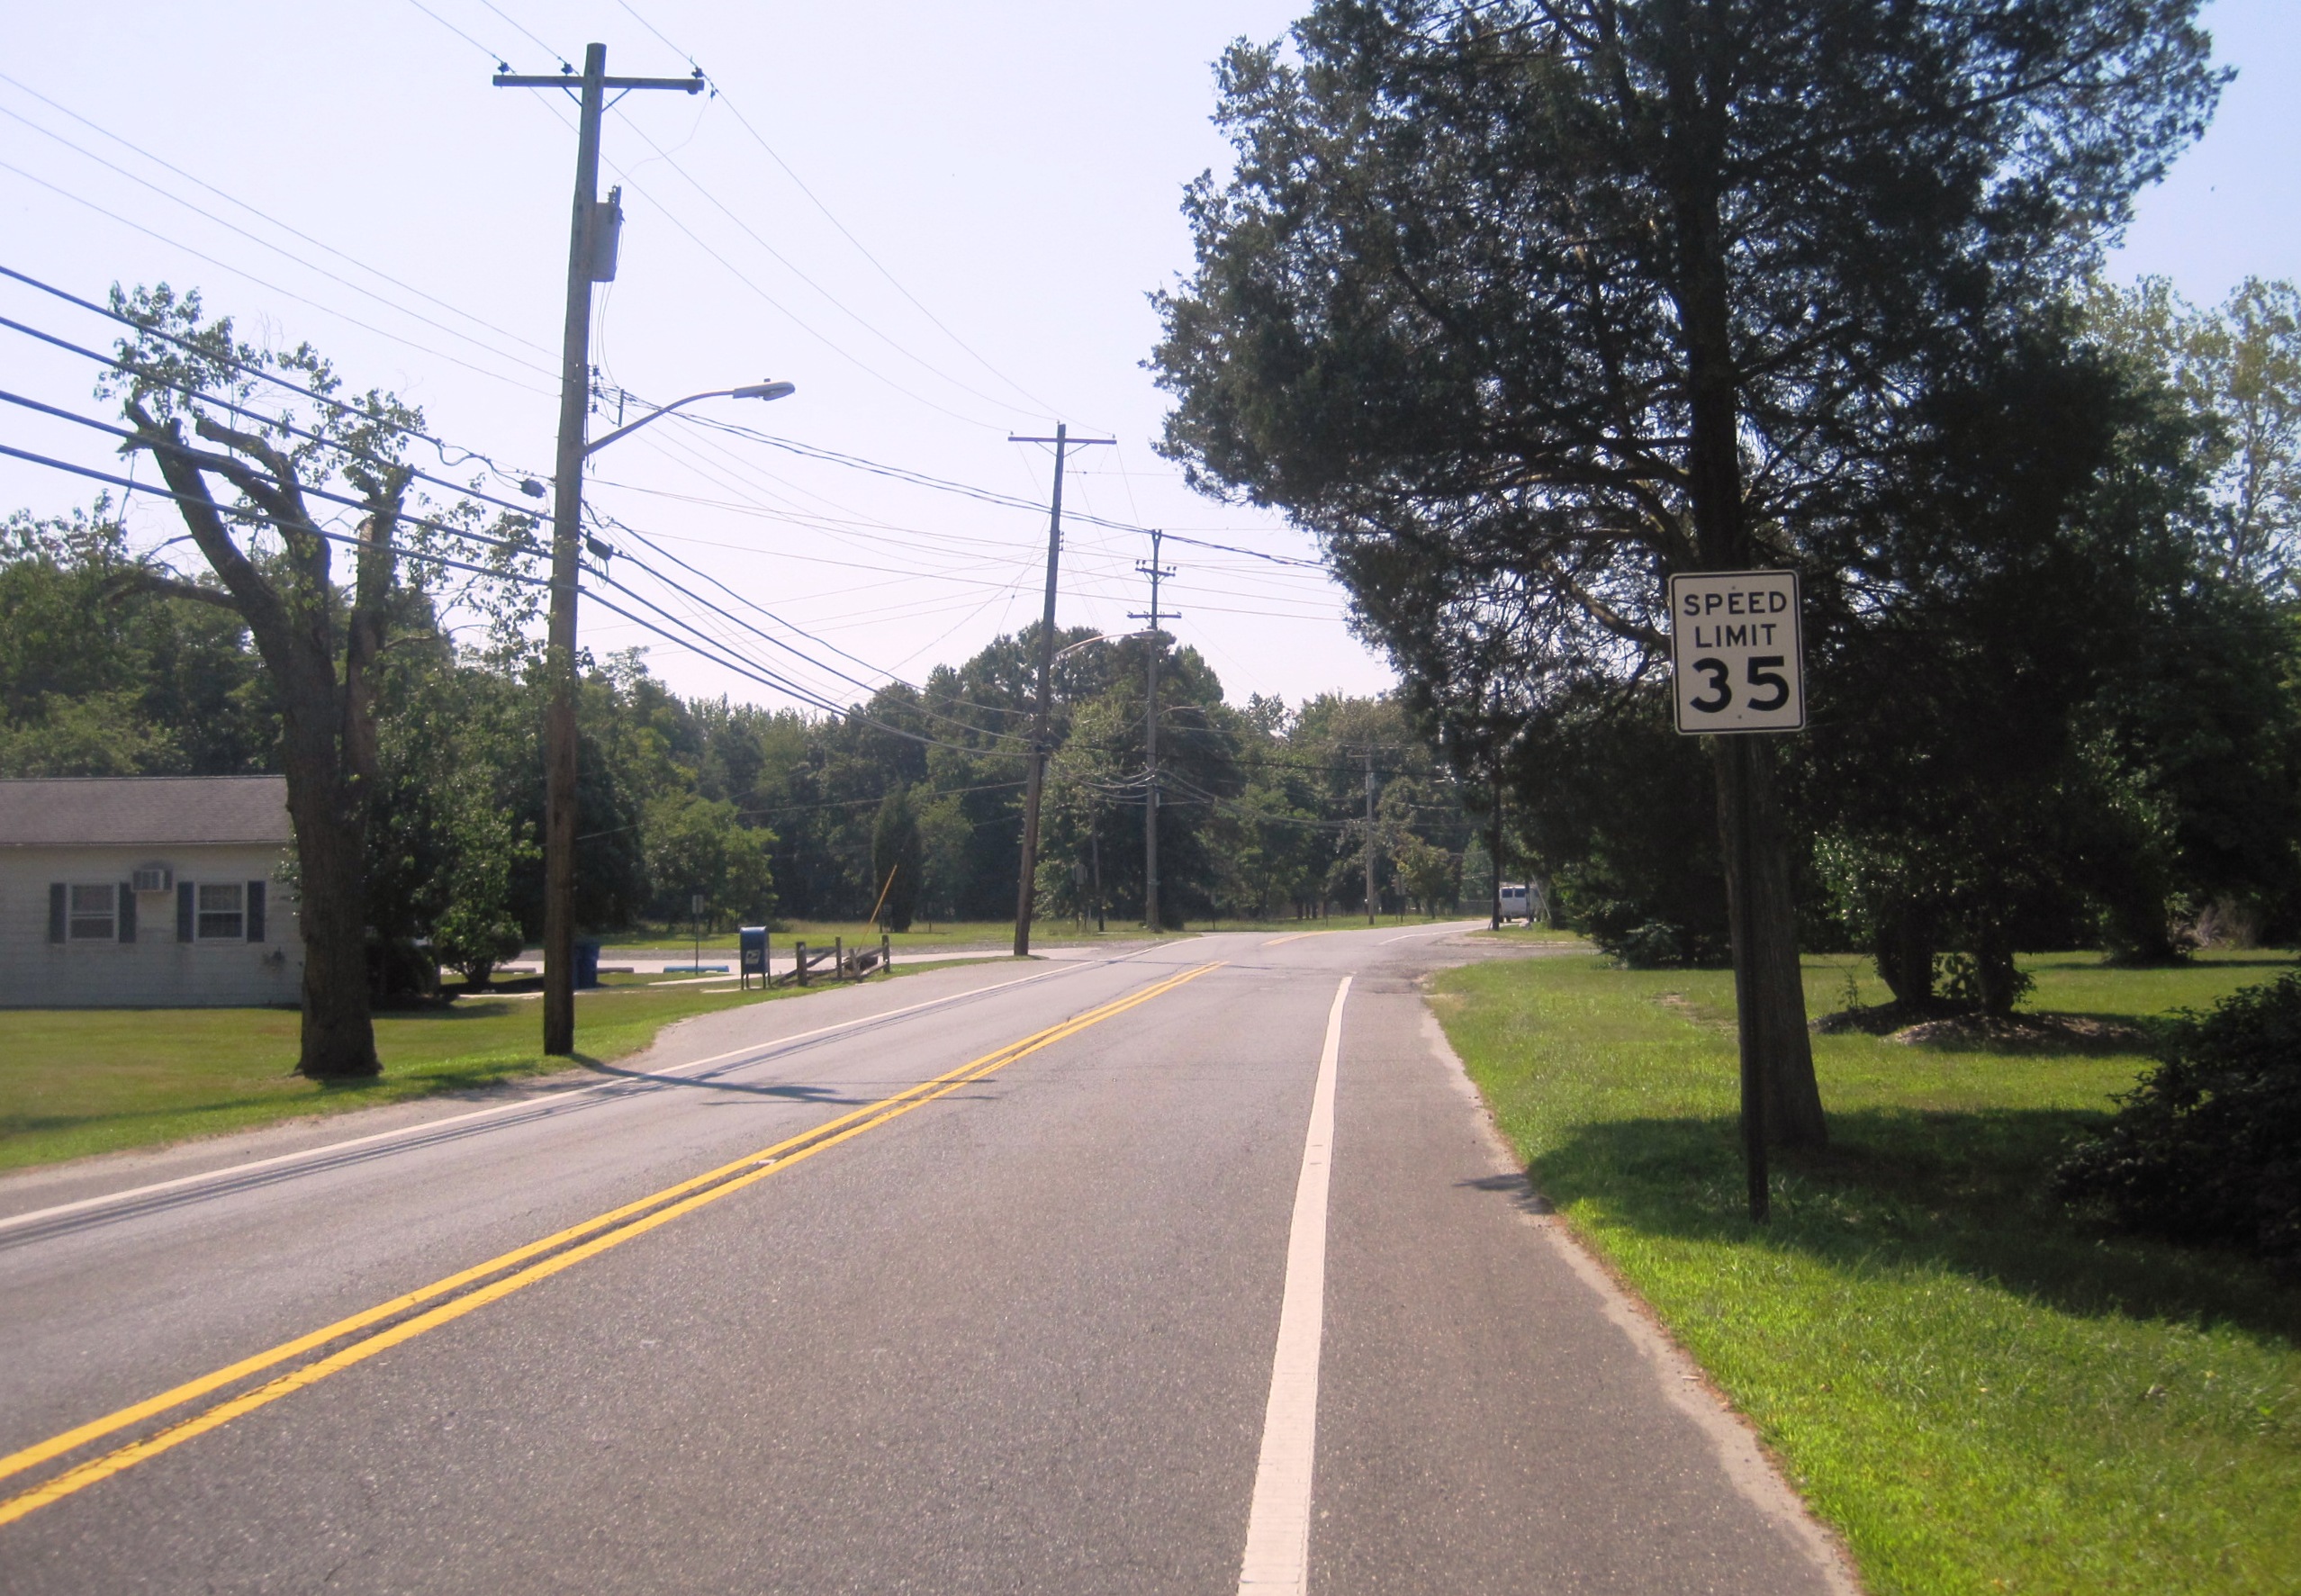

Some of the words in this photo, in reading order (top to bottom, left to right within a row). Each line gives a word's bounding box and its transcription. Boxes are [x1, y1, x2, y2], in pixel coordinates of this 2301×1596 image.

[1683, 591, 1787, 617] SPEED
[1694, 624, 1777, 648] LIMIT
[1690, 655, 1790, 714] 35
